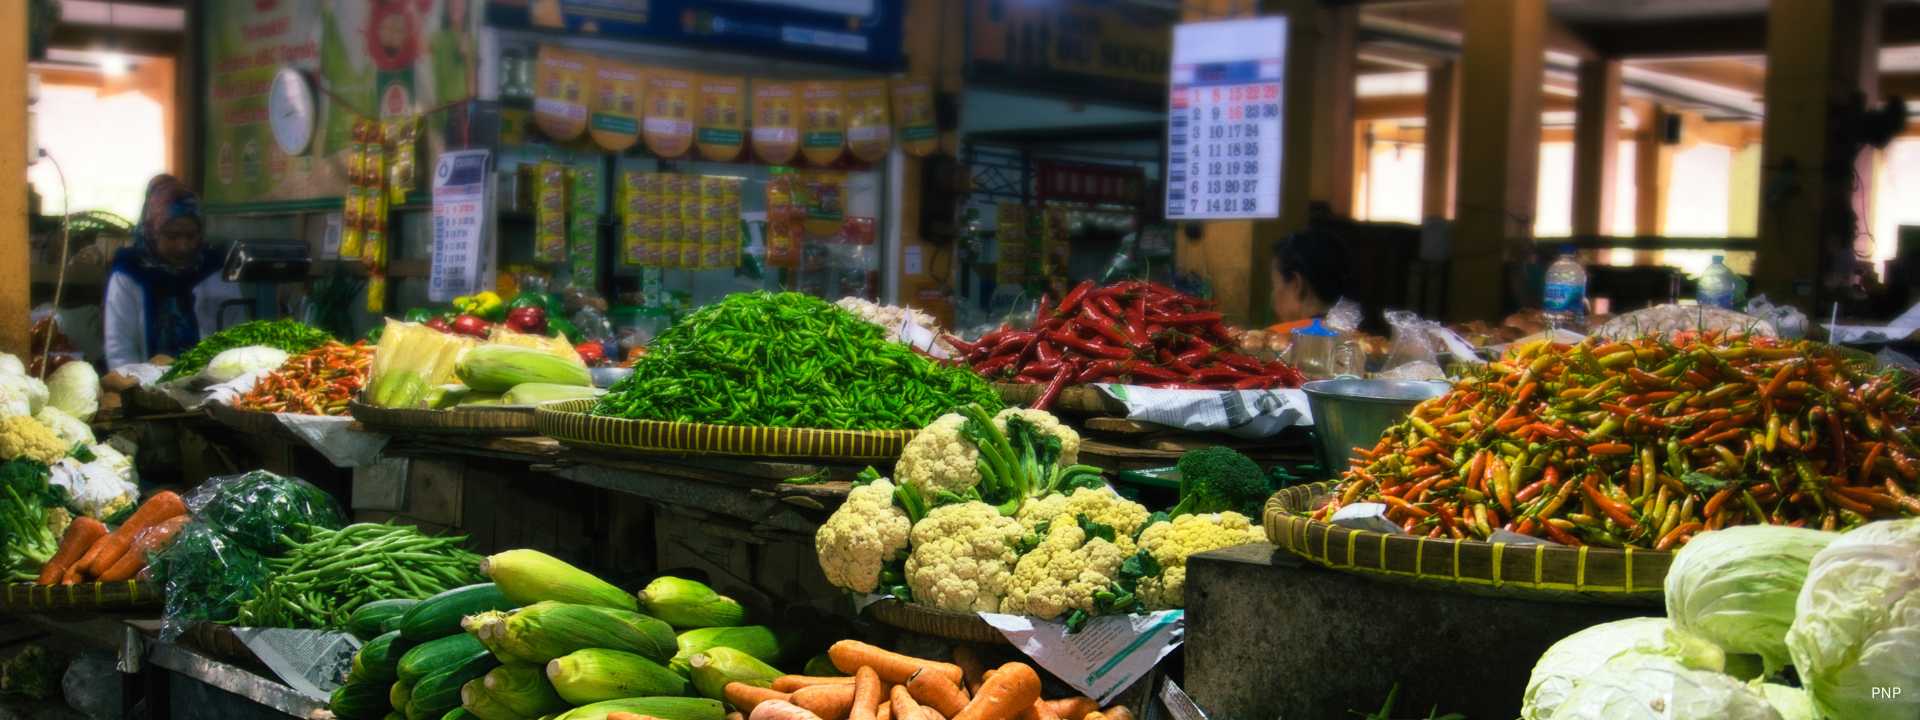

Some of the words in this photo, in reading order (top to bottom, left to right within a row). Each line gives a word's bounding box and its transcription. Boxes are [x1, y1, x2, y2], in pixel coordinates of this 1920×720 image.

[1228, 87, 1242, 101] 15
[1246, 86, 1260, 101] 22
[1263, 86, 1278, 99] 29
[1193, 107, 1200, 120] 2
[1212, 107, 1220, 119] 9
[1227, 107, 1242, 120] 16
[1246, 105, 1260, 118] 23
[1263, 104, 1278, 117] 30
[1192, 127, 1199, 138] 3
[1209, 126, 1223, 138] 10
[1227, 125, 1241, 138] 17
[1245, 124, 1259, 136] 24
[1192, 145, 1199, 156] 4
[1208, 145, 1221, 156] 11
[1227, 144, 1241, 156] 18
[1244, 143, 1259, 156] 25
[1192, 163, 1199, 175] 5
[1208, 163, 1222, 175] 12
[1226, 162, 1240, 174] 19
[1244, 161, 1258, 174] 26
[1191, 181, 1198, 193] 6
[1207, 181, 1221, 193] 13
[1225, 180, 1240, 193] 20
[1243, 180, 1258, 192] 27
[1190, 200, 1198, 211] 7
[1206, 200, 1220, 211] 14
[1224, 199, 1238, 211] 21
[1242, 199, 1256, 211] 28
